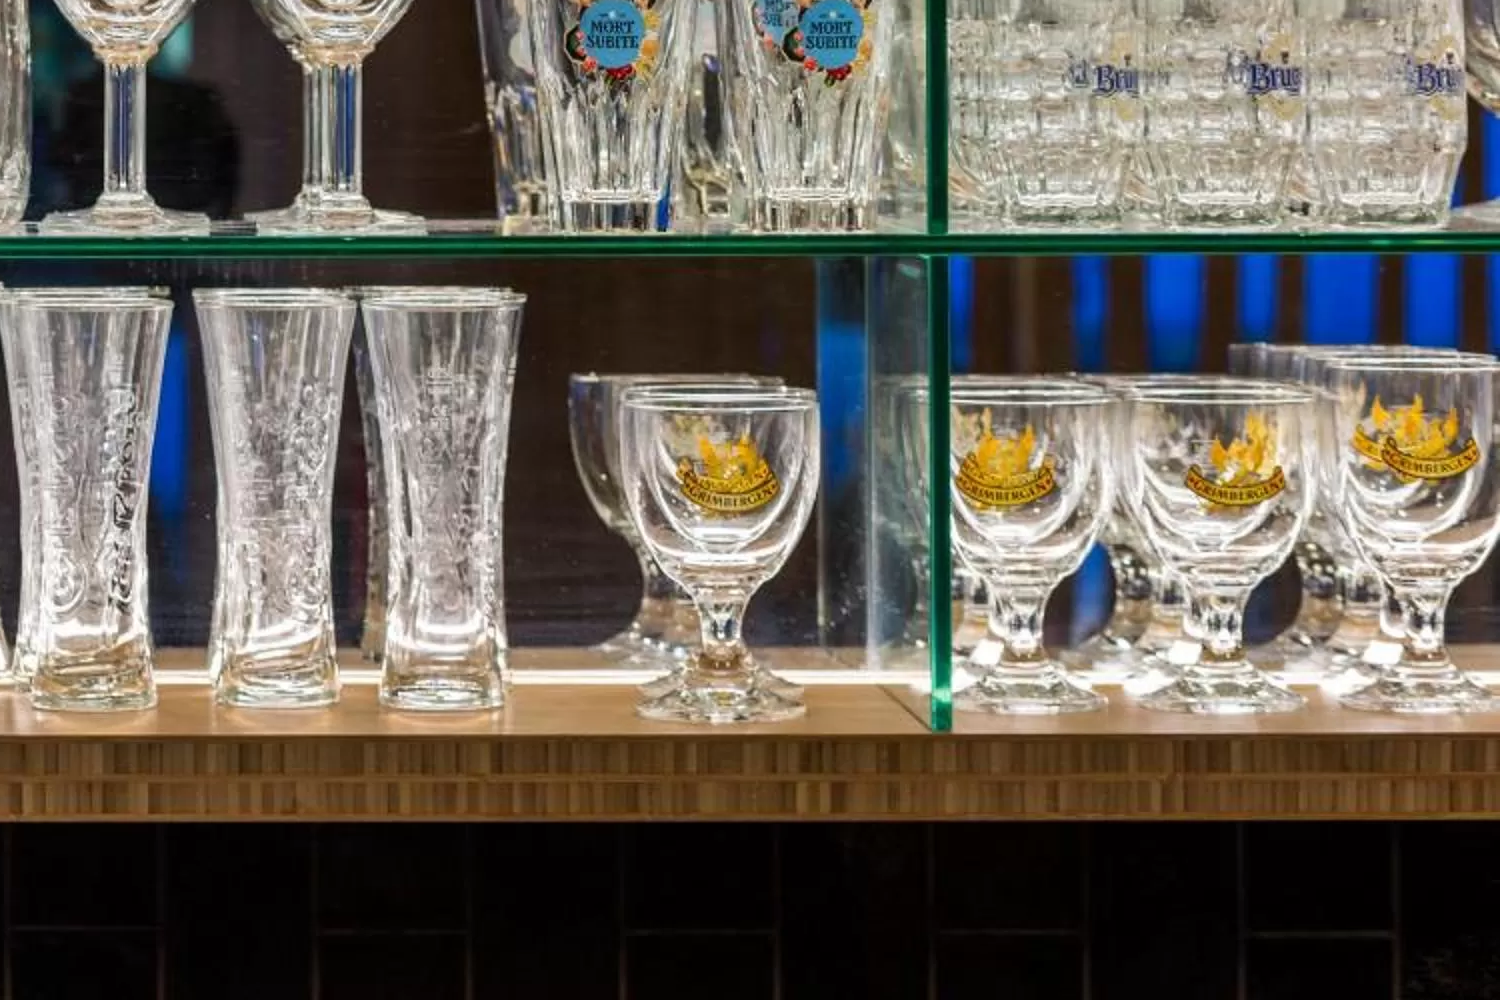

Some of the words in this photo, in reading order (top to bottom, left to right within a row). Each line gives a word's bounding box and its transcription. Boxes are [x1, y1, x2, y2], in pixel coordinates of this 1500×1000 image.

[591, 20, 635, 33] MORT
[810, 21, 853, 34] MORT
[585, 35, 639, 49] SUBITE
[805, 35, 857, 49] SUBITE
